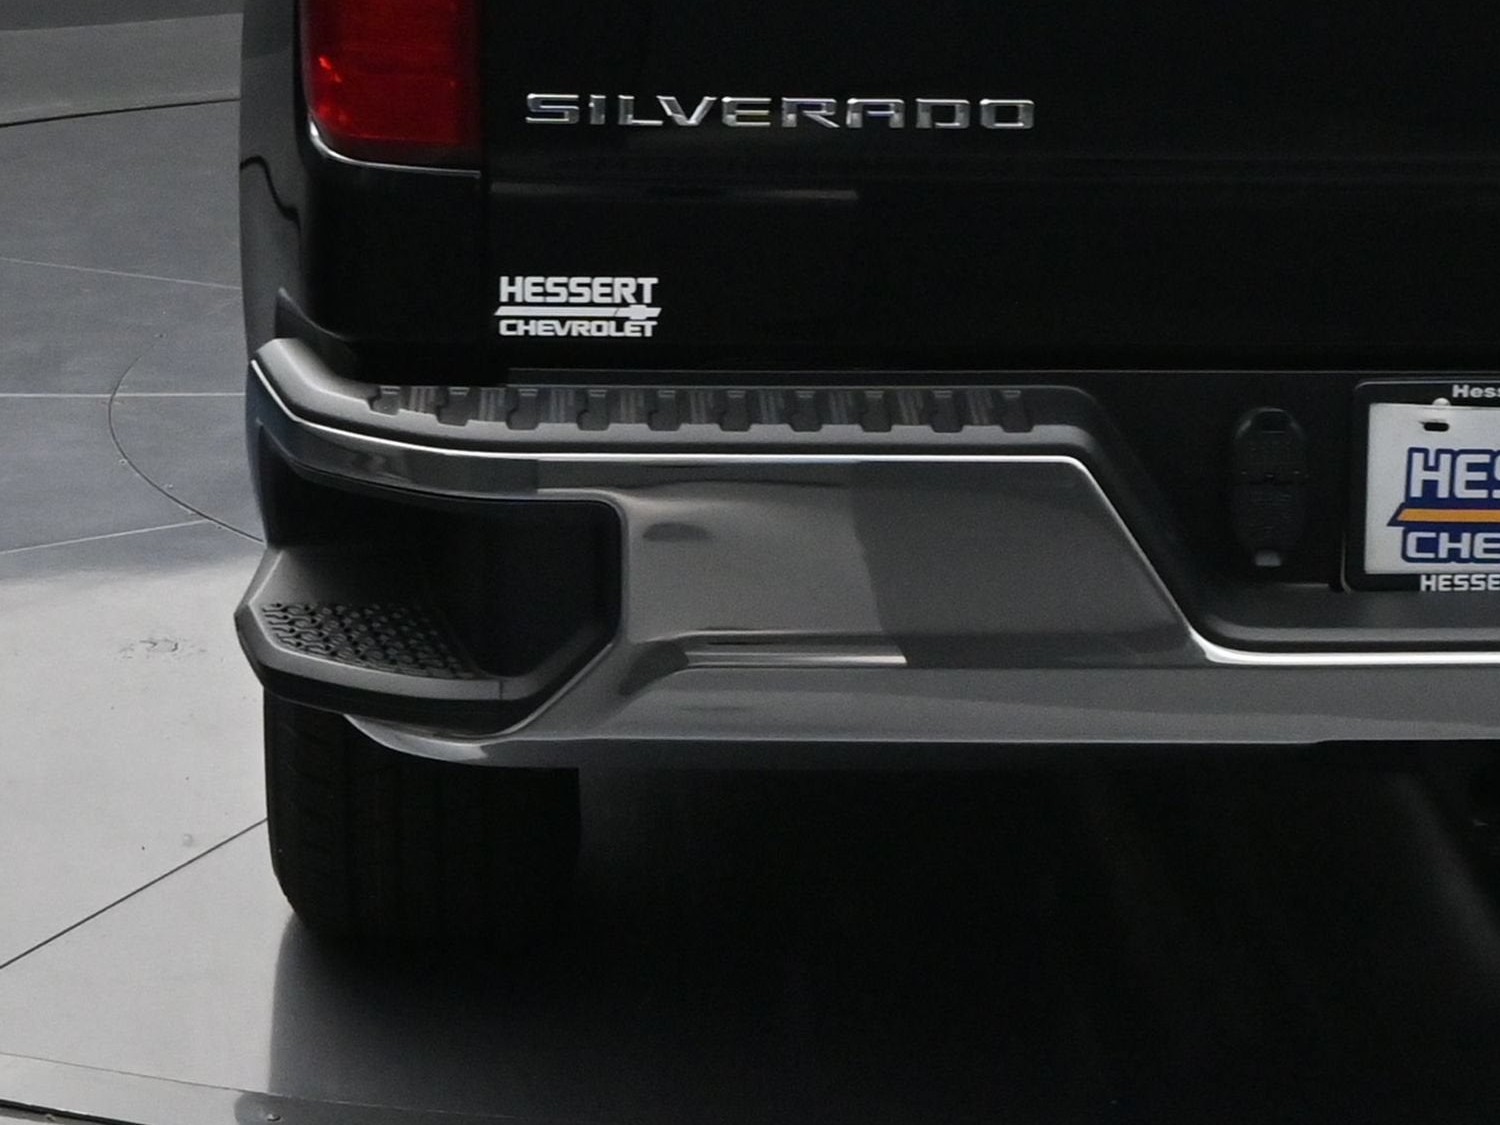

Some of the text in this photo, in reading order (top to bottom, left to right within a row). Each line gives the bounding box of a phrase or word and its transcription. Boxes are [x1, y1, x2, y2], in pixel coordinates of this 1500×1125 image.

[525, 93, 1036, 131] SILVERADO
[499, 276, 659, 305] HESSERT
[499, 320, 658, 338] CHEVROLET
